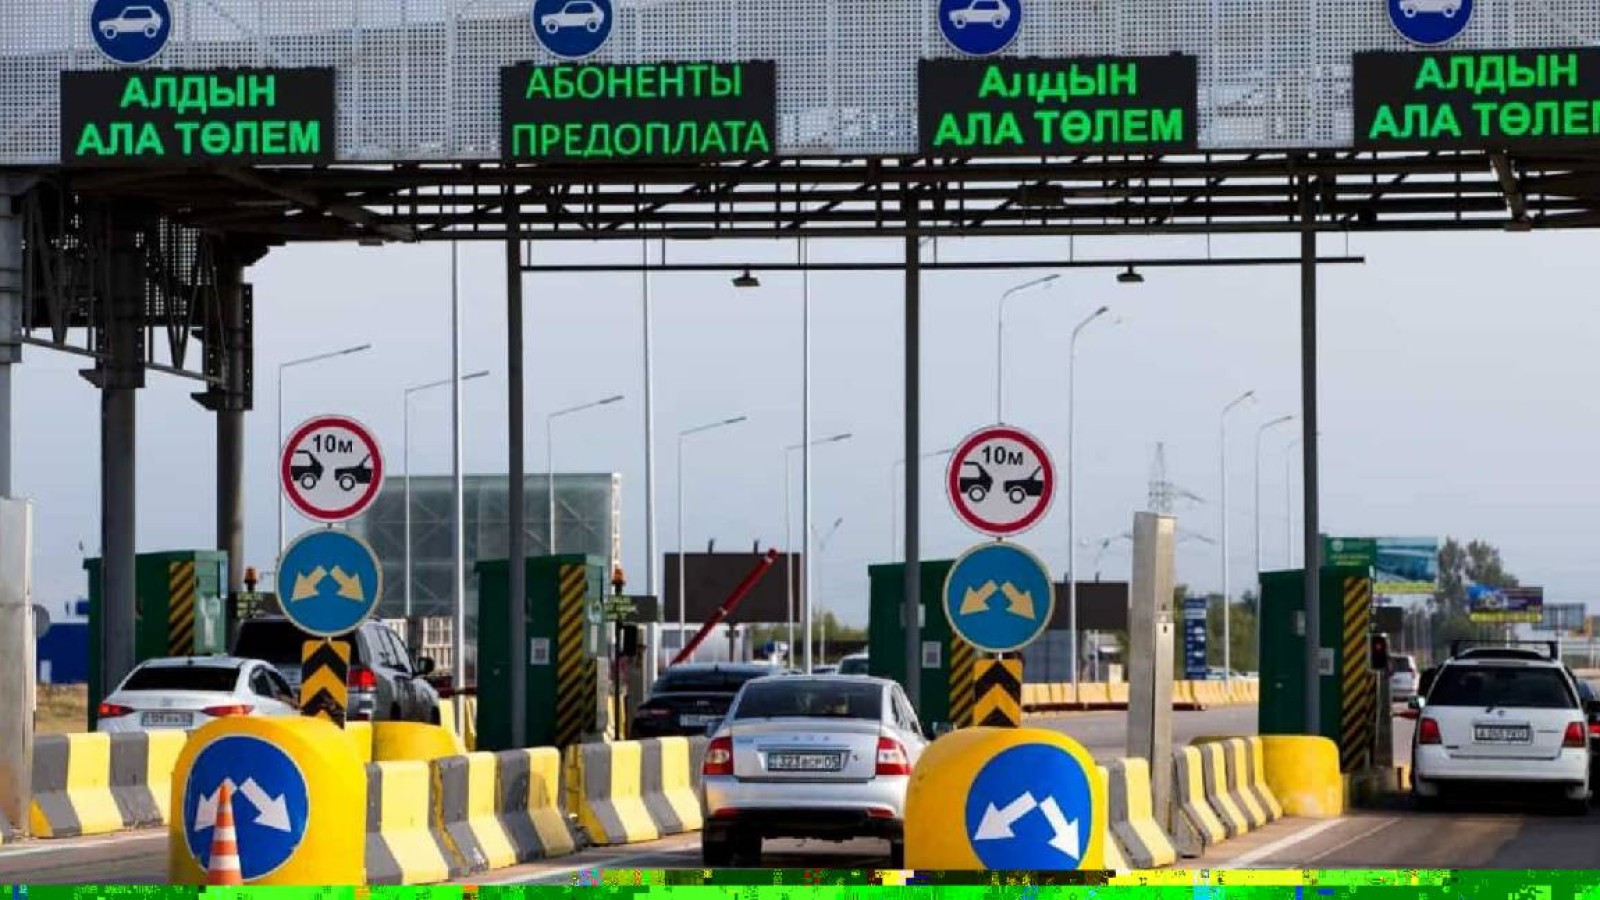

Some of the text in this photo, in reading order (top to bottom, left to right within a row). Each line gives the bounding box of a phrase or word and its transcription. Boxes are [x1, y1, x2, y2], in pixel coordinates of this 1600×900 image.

[526, 64, 742, 99] АБОНЕНТЫ
[1414, 53, 1577, 95] АЛДЫН
[120, 74, 275, 114] АЛДЫН
[76, 120, 320, 156] АЛА ТӨЛЕМ
[512, 120, 769, 157] ПРЕДОПЛАТА
[933, 108, 1183, 146] АЛА ТӨЛЕМ
[1369, 100, 1600, 139] АЛА ТӨЛЕ
